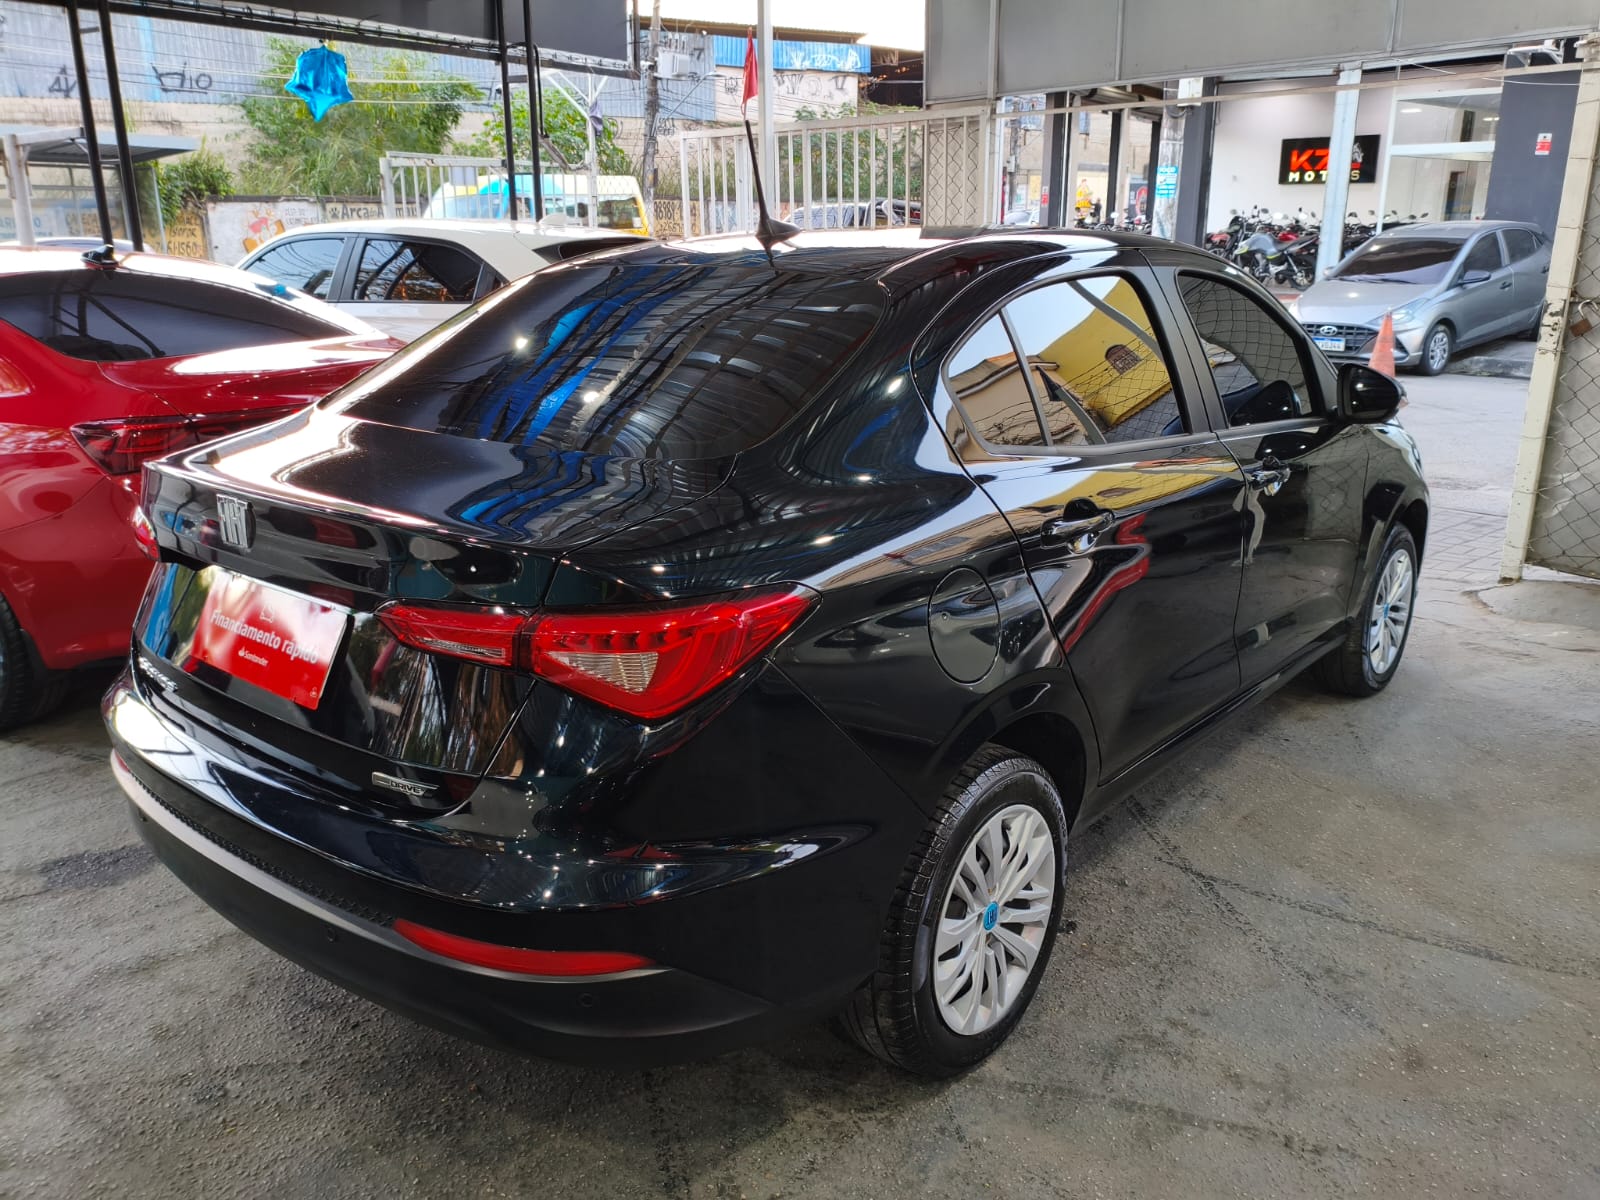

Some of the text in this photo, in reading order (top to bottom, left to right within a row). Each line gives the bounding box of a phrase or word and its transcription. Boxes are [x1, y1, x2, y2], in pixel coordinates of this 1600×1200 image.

[1289, 170, 1360, 182] MOTS
[341, 203, 369, 219] Arca
[216, 494, 248, 549] FIAT
[210, 609, 281, 650] Financiamento
[390, 780, 422, 794] DRIVE
